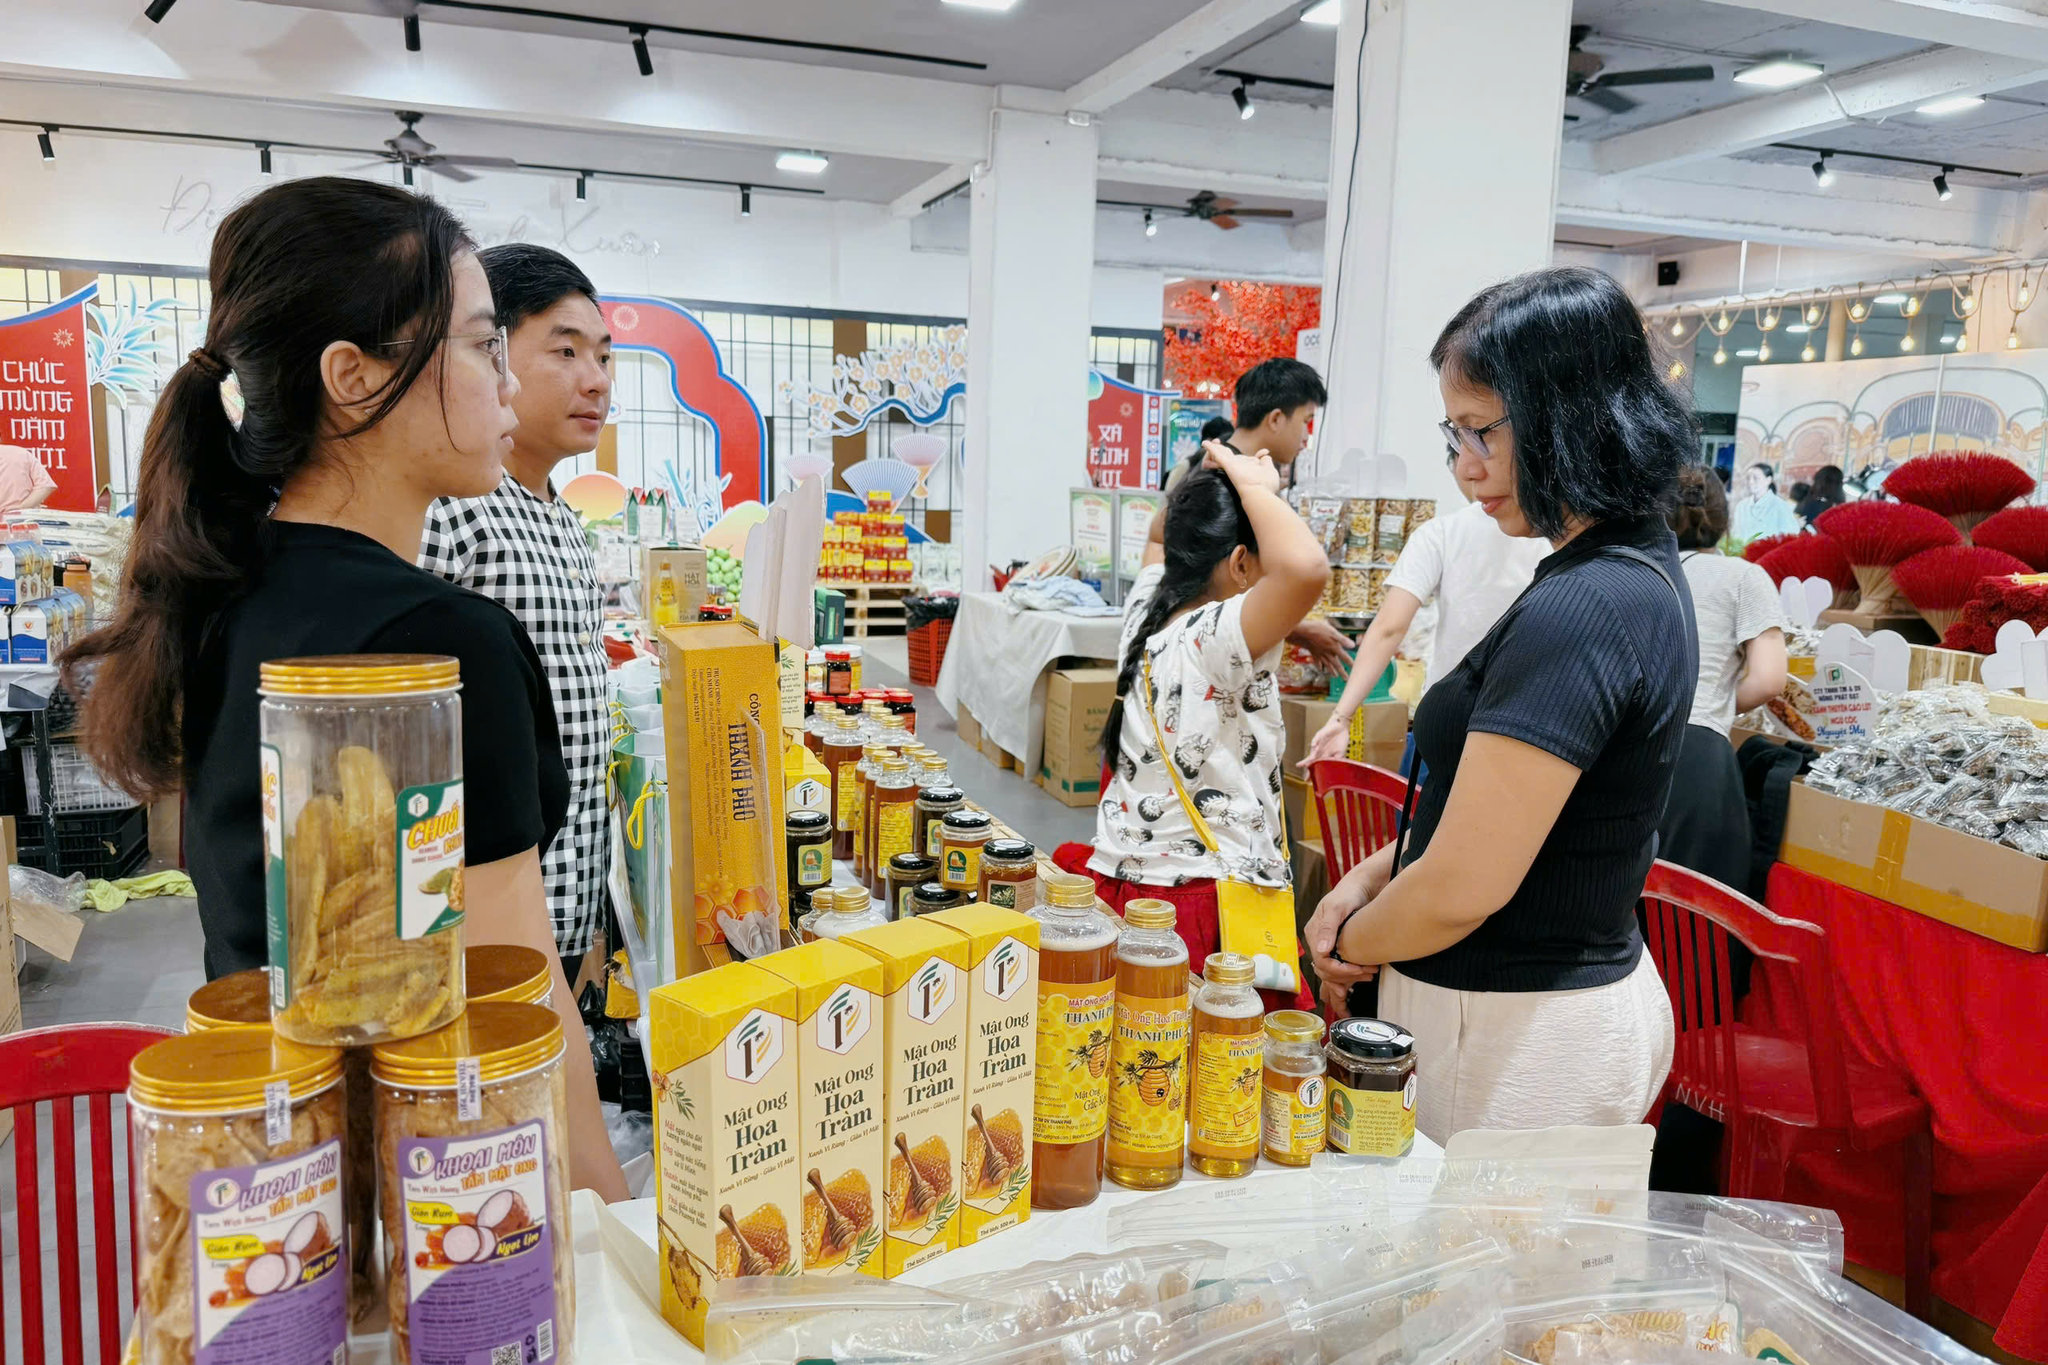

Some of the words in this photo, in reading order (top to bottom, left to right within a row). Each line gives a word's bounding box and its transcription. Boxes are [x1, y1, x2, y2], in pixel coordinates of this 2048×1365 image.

[3, 357, 66, 384] CHÚC
[0, 386, 74, 412] MỪNG
[11, 416, 65, 441] NĂM
[979, 1022, 1002, 1038] Mật
[1005, 1012, 1030, 1028] Ong
[1064, 1007, 1105, 1024] THANH
[988, 1034, 1020, 1056] Hoa
[1118, 1025, 1163, 1042] THANH
[903, 1045, 928, 1063] Mật
[931, 1034, 957, 1051] Ong
[911, 1058, 947, 1083] Hoa
[980, 1052, 1027, 1079] Tràm
[814, 1077, 841, 1097] Mật
[845, 1063, 874, 1084] Ong
[903, 1076, 954, 1106] Tràm
[724, 1108, 753, 1129] Mật
[756, 1091, 788, 1114] Ong
[824, 1089, 864, 1116] Hoa
[735, 1119, 777, 1150] Hoa
[815, 1107, 872, 1141] Tràm
[435, 1147, 493, 1181] KHOAI
[497, 1133, 537, 1163] MÔN
[726, 1138, 787, 1175] Tràm
[239, 1168, 302, 1212] KHOAI
[305, 1151, 338, 1185] MÔN
